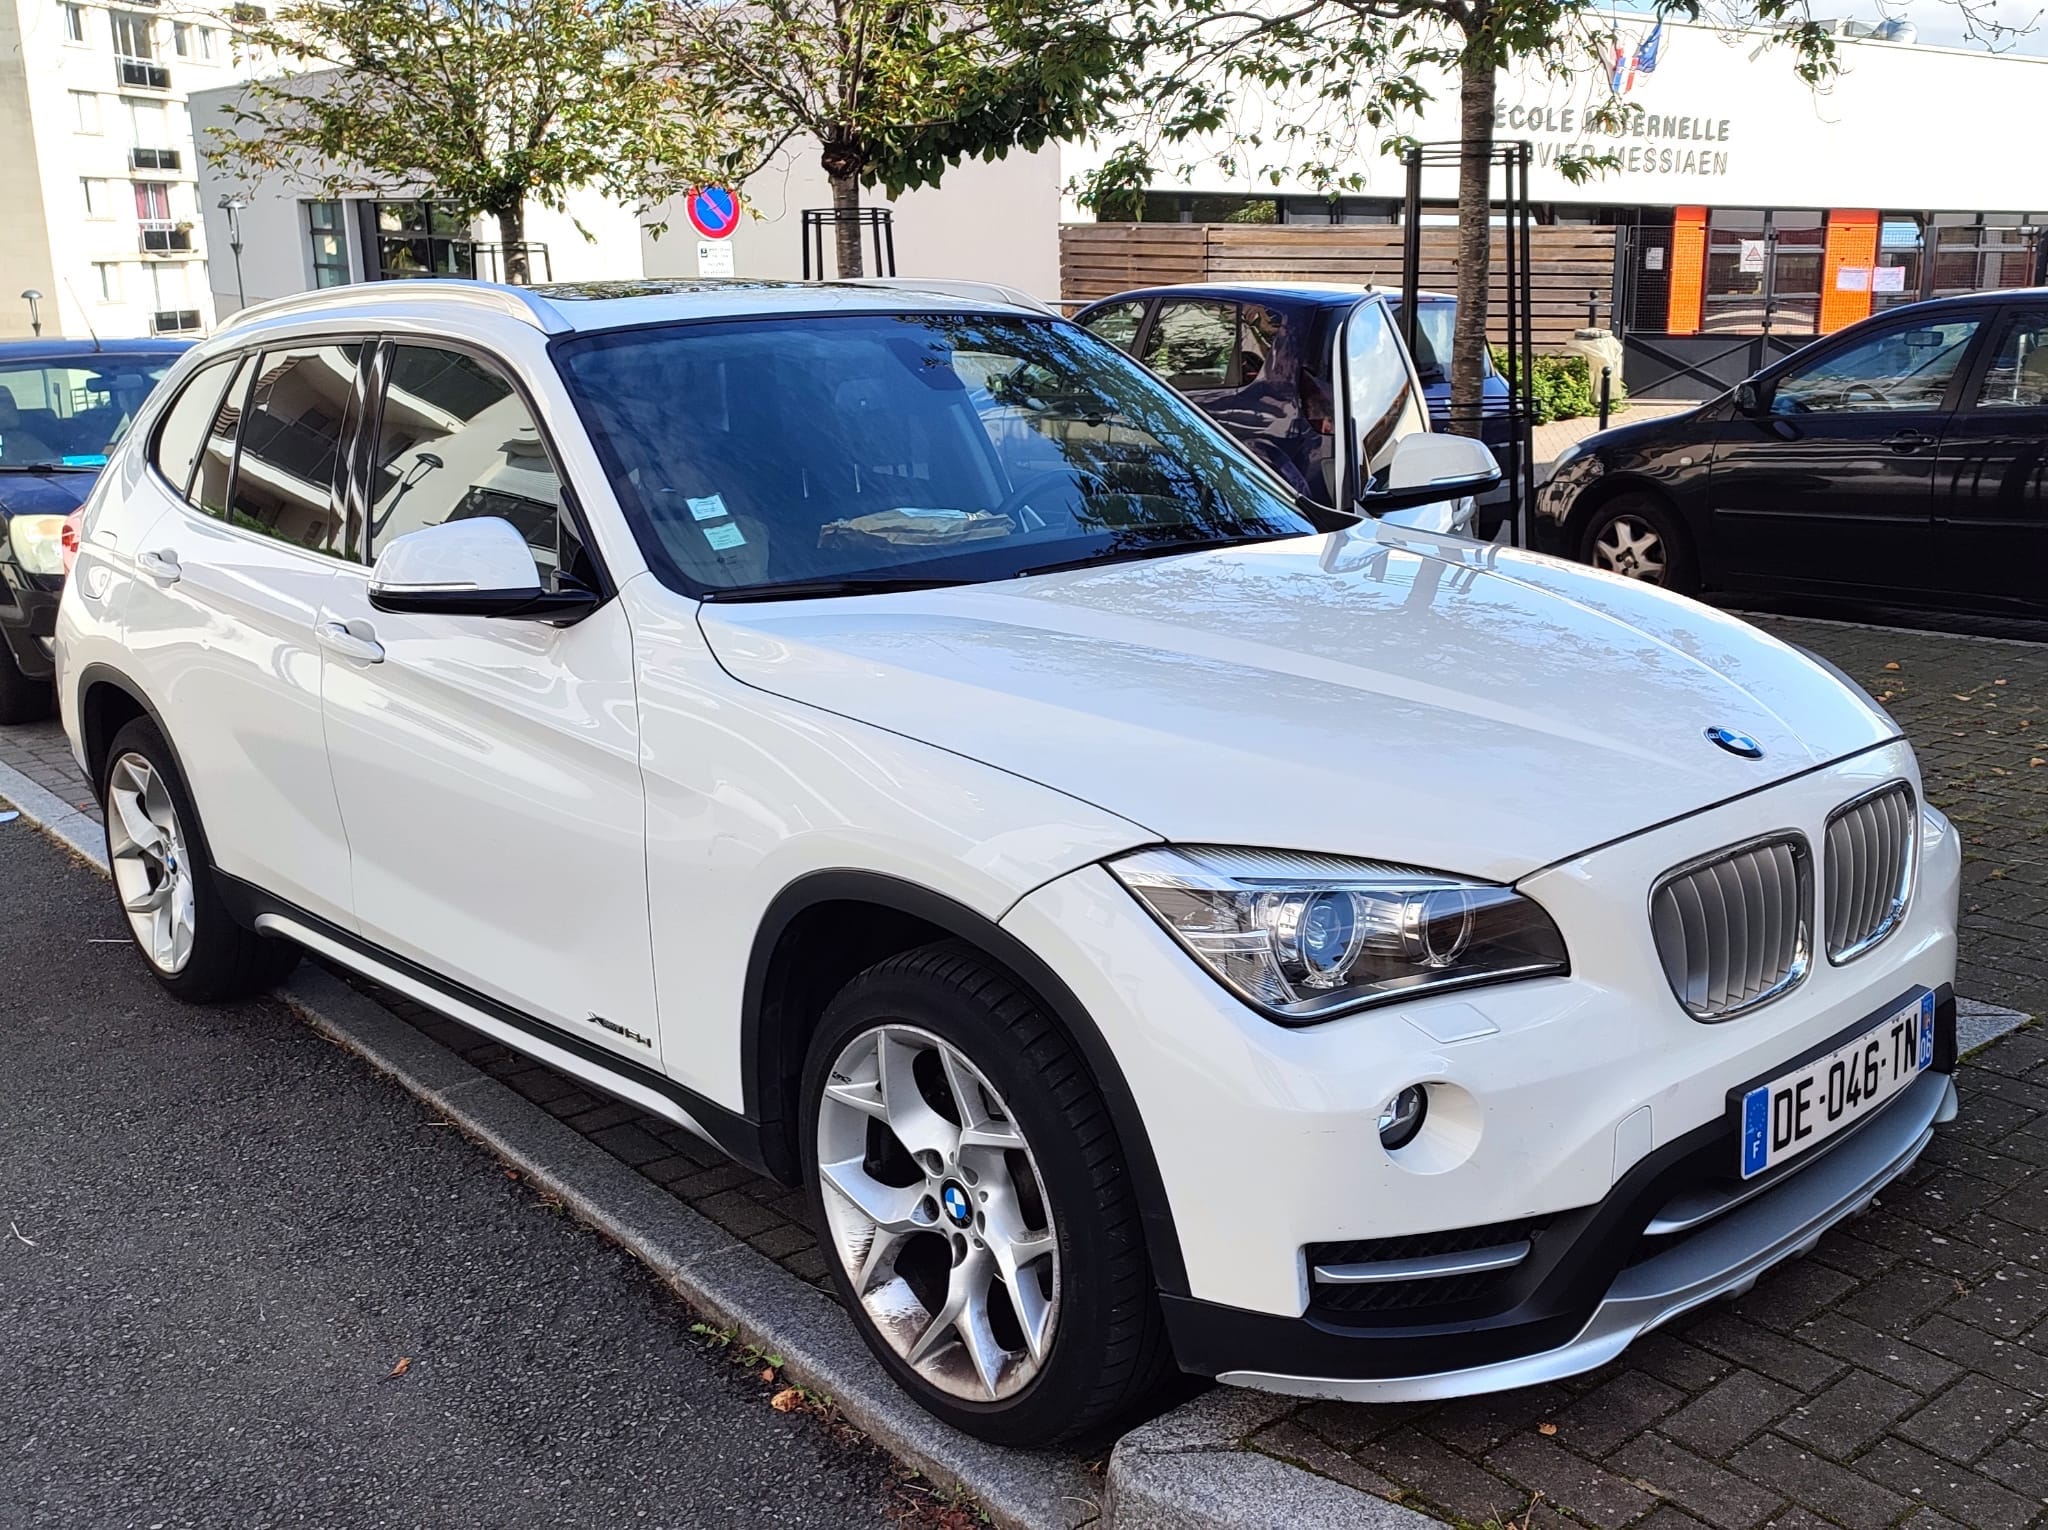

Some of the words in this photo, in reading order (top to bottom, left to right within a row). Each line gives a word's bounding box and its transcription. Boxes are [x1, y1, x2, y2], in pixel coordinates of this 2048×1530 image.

[1494, 98, 1575, 133] ÉCOLE
[1585, 109, 1730, 142] MERNELLE
[1752, 1139, 1761, 1160] F
